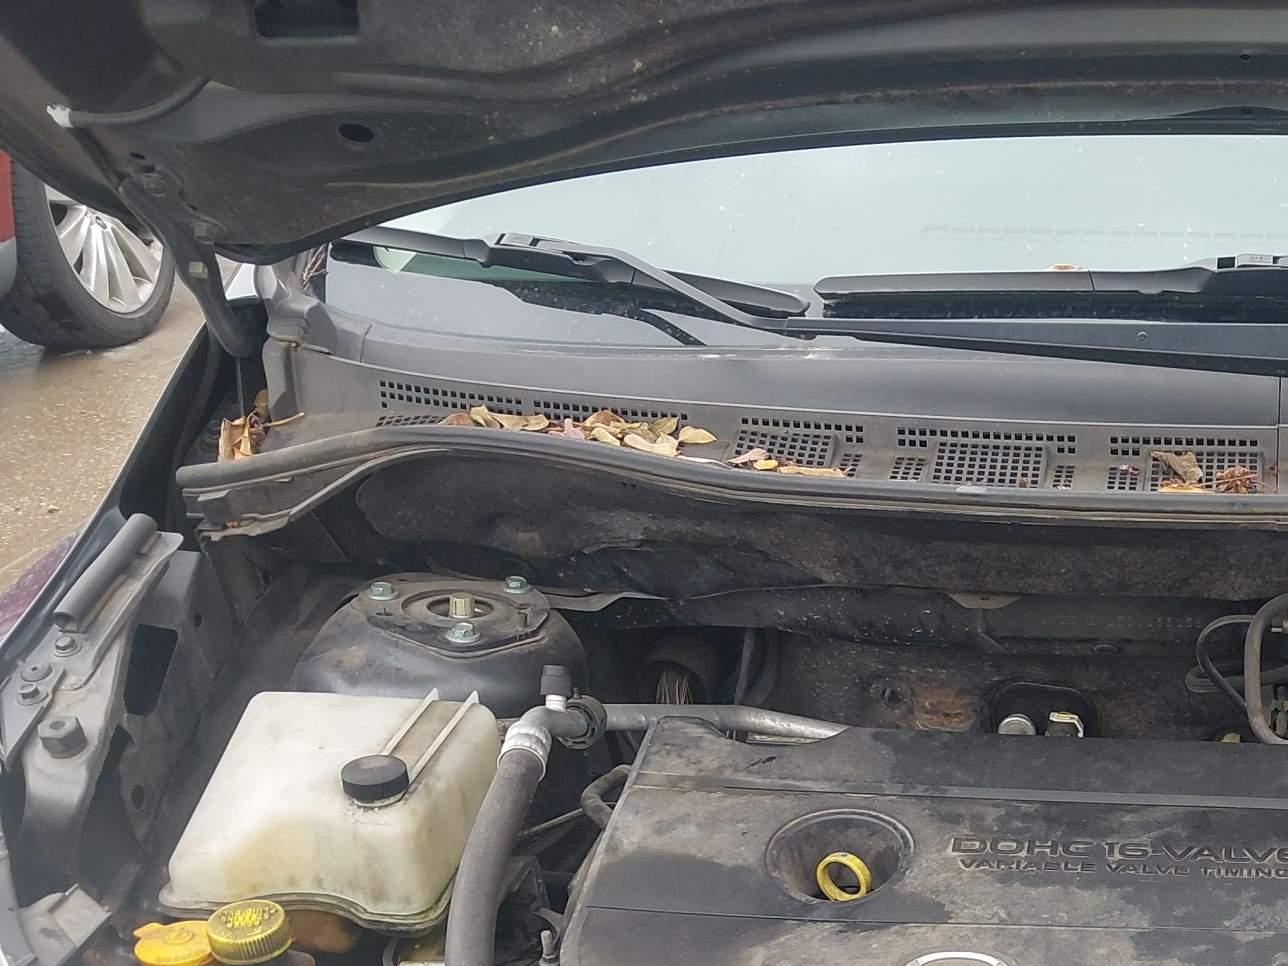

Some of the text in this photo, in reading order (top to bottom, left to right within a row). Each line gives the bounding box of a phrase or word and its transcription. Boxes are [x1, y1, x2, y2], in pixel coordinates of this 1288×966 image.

[951, 836, 1097, 857] DOHC
[958, 858, 1097, 873] VARIABLE
[1105, 862, 1193, 877] VALVE
